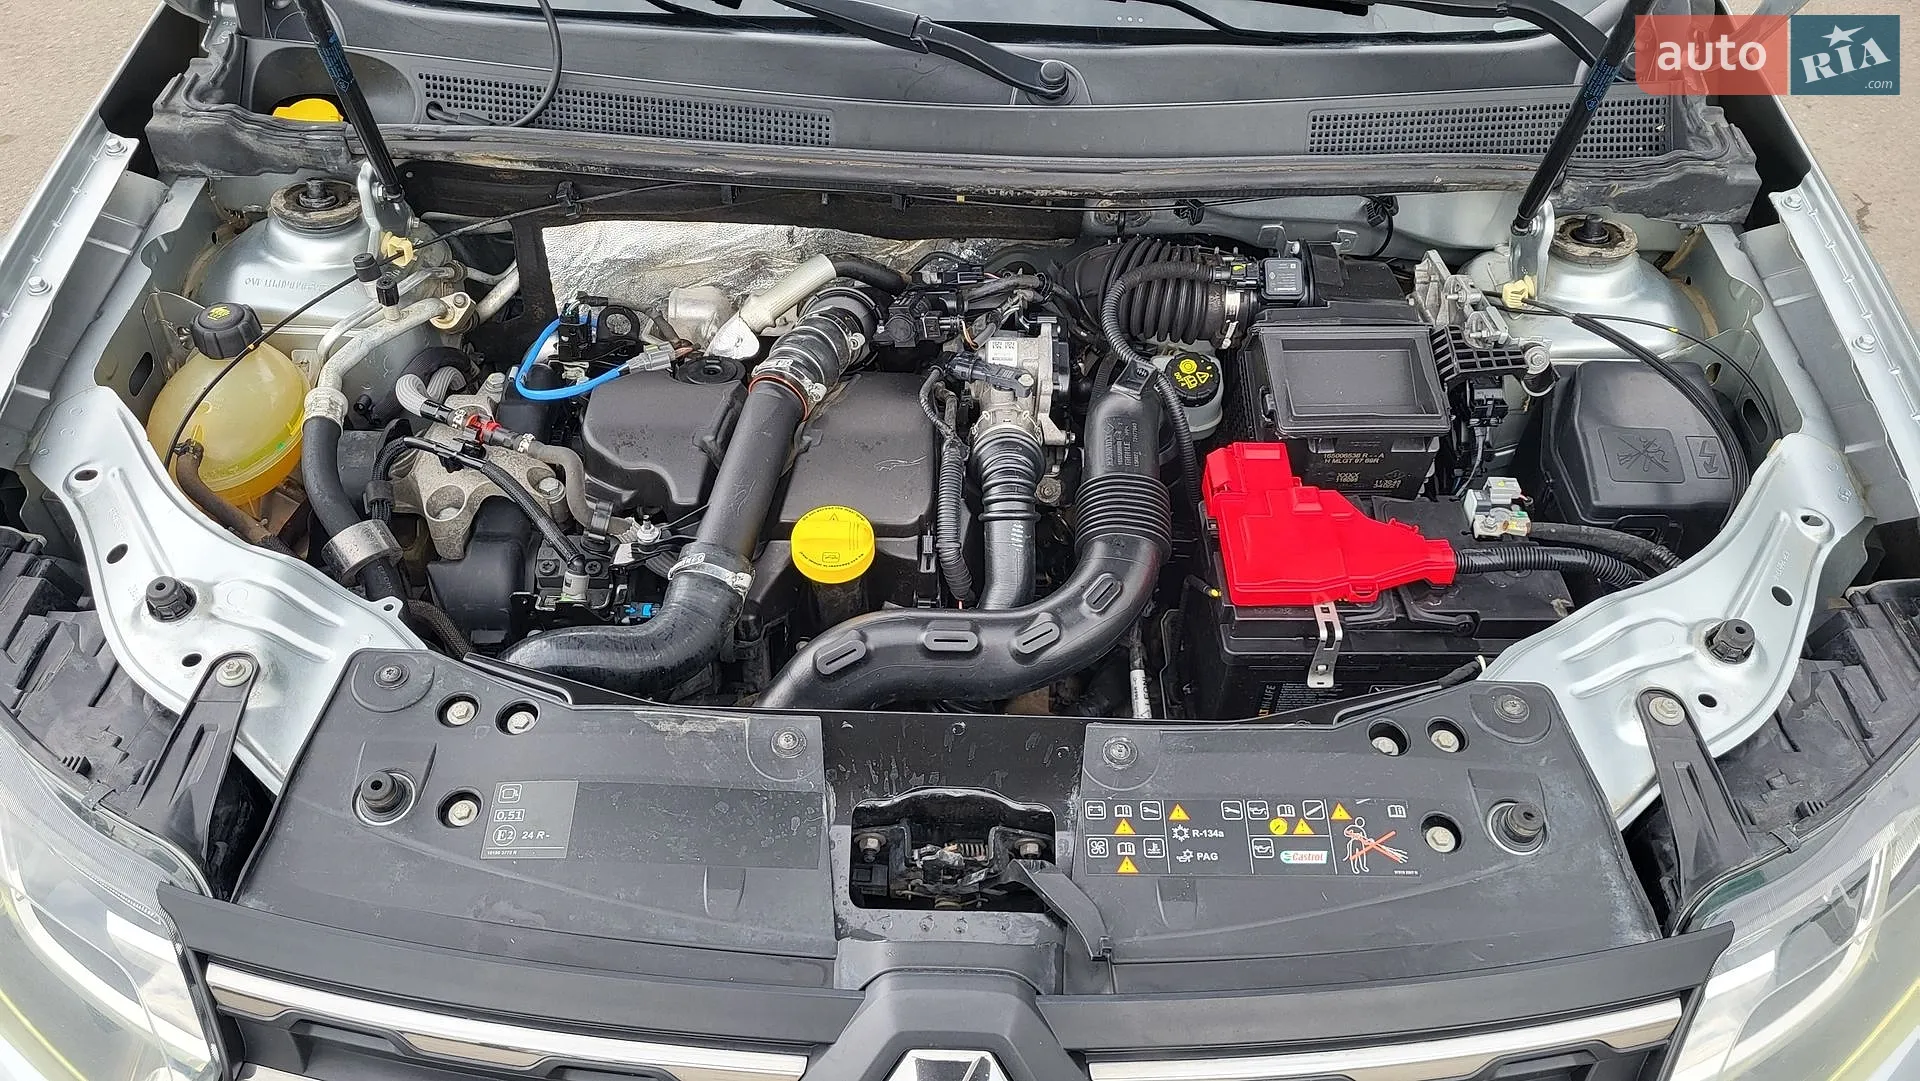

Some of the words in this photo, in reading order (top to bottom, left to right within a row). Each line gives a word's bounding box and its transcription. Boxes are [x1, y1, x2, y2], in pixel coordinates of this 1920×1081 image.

[496, 811, 522, 821] 0,51
[521, 831, 534, 840] 24
[1191, 829, 1225, 838] R-134a
[1196, 852, 1219, 862] PAG
[1292, 852, 1323, 861] Castrol
